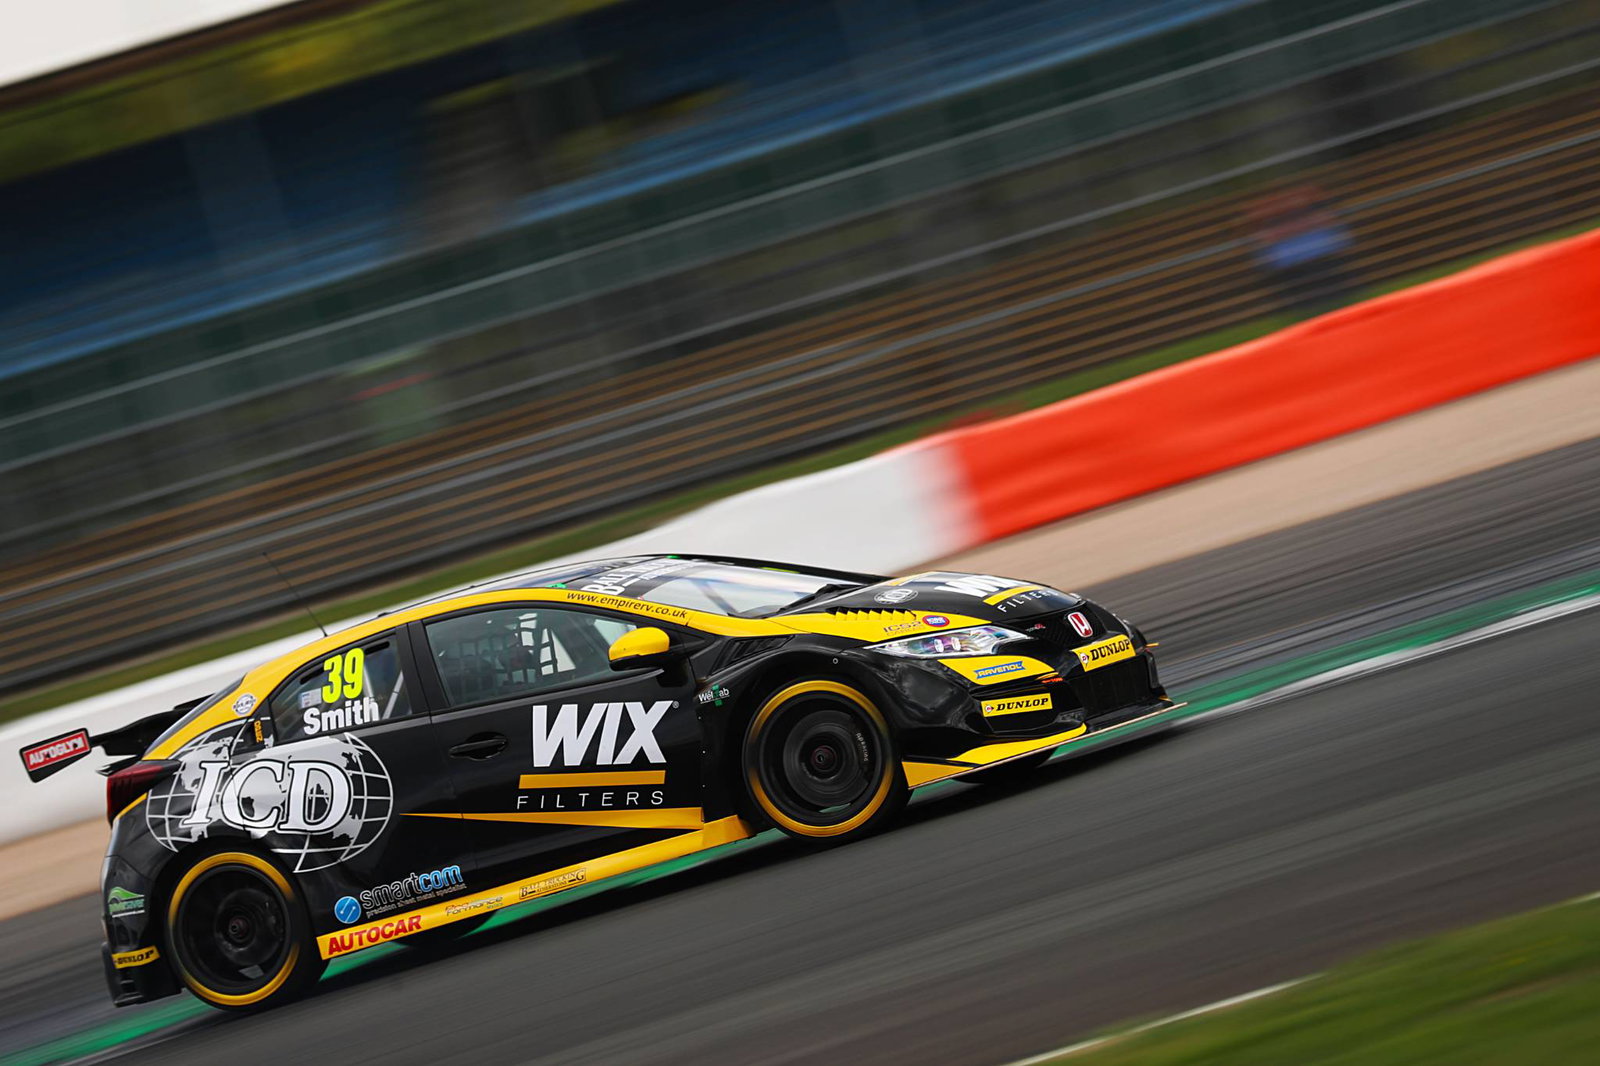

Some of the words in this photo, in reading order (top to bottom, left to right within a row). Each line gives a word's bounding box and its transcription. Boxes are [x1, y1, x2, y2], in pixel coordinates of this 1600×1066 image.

[566, 591, 689, 619] www.empirerv.co.uk
[1091, 637, 1131, 662] DUNLOP
[322, 647, 364, 704] 39
[303, 696, 380, 735] Smith
[996, 697, 1049, 712] DUNLOP
[532, 700, 674, 768] WIX
[182, 760, 351, 832] ICD
[516, 790, 664, 811] FILTERS
[360, 864, 464, 910] smartcom
[327, 914, 422, 956] AUTOCAR
